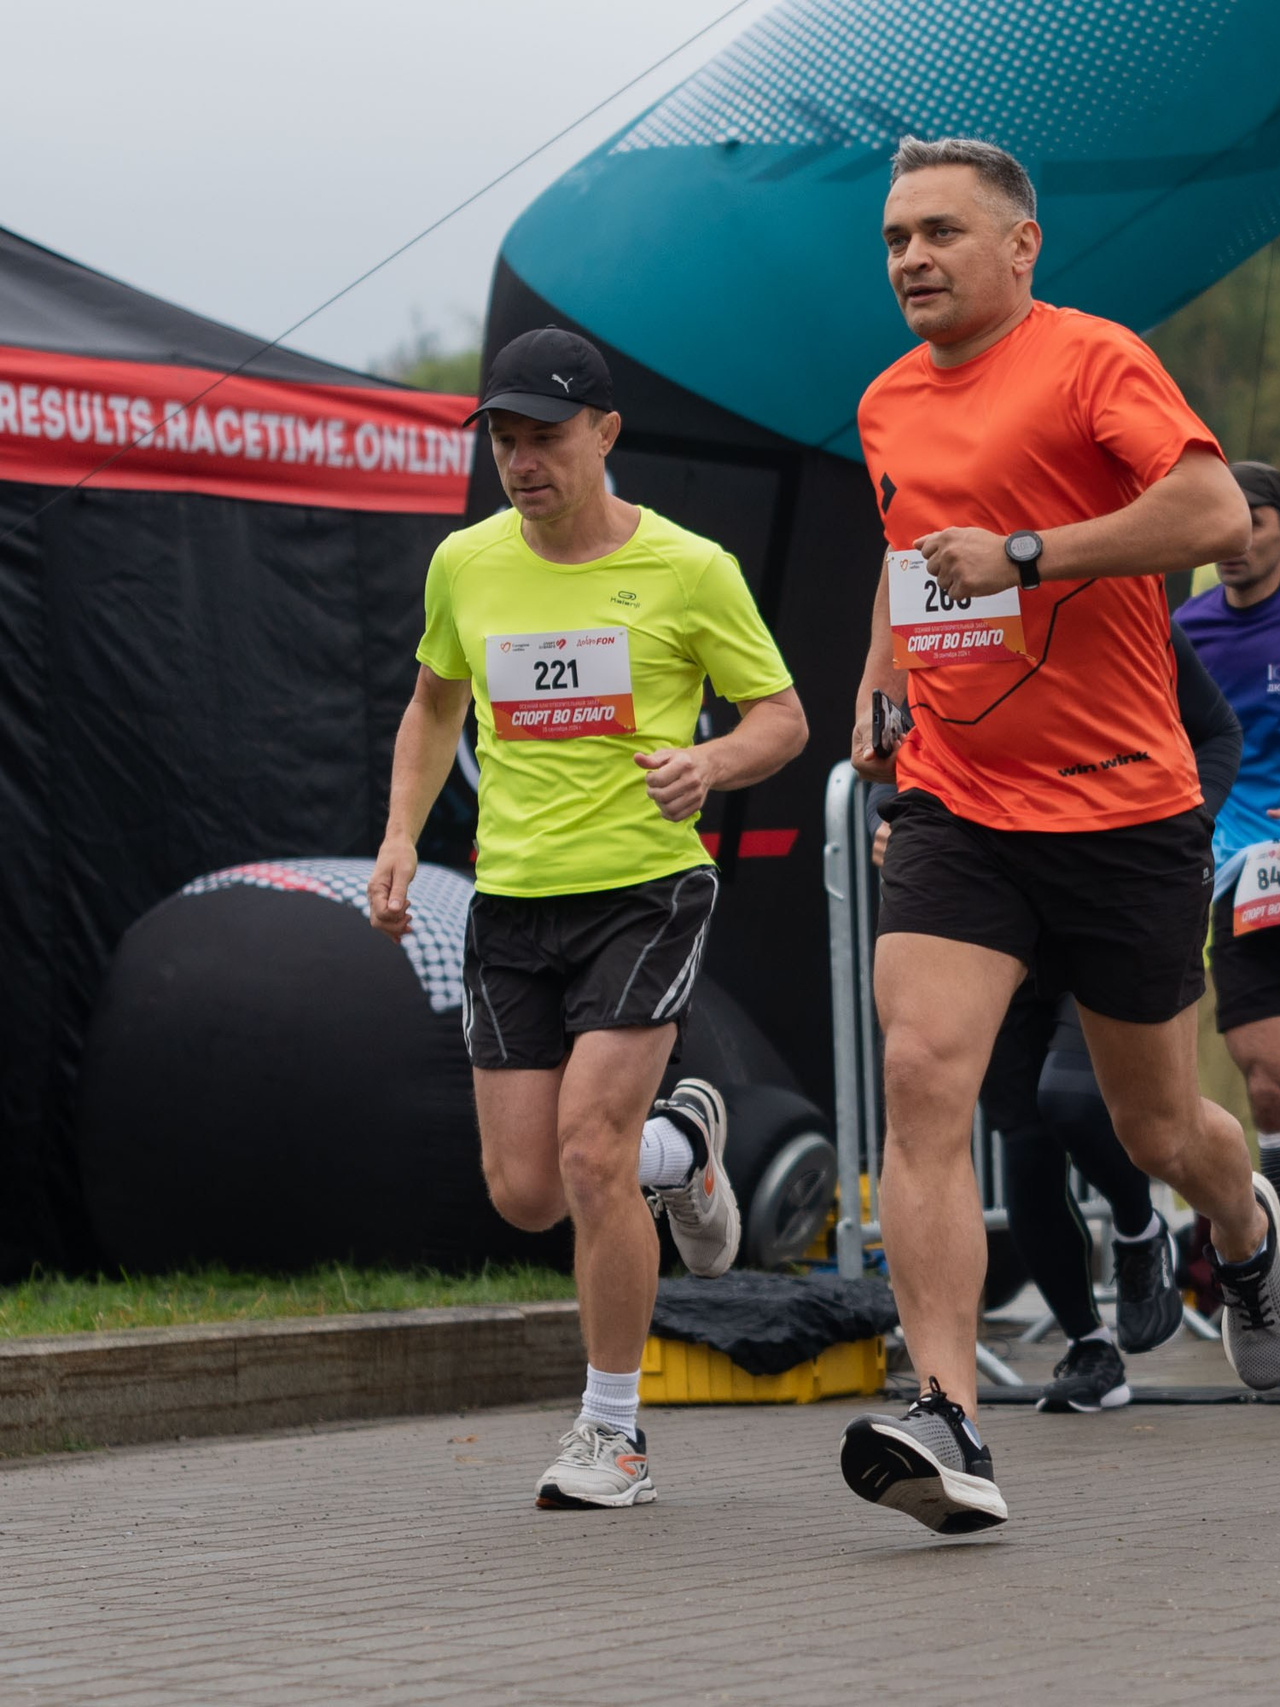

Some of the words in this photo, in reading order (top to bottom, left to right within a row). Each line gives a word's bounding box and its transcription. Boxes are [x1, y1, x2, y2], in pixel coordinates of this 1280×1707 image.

[907, 633, 942, 652] СПОРТ
[942, 632, 960, 650] ВО
[961, 629, 1004, 648] БЛАГО
[533, 659, 579, 690] 221
[511, 710, 552, 726] СПОРТ
[552, 708, 571, 724] ВО
[572, 706, 615, 723] БЛАГО
[1242, 905, 1266, 923] СПОРТ
